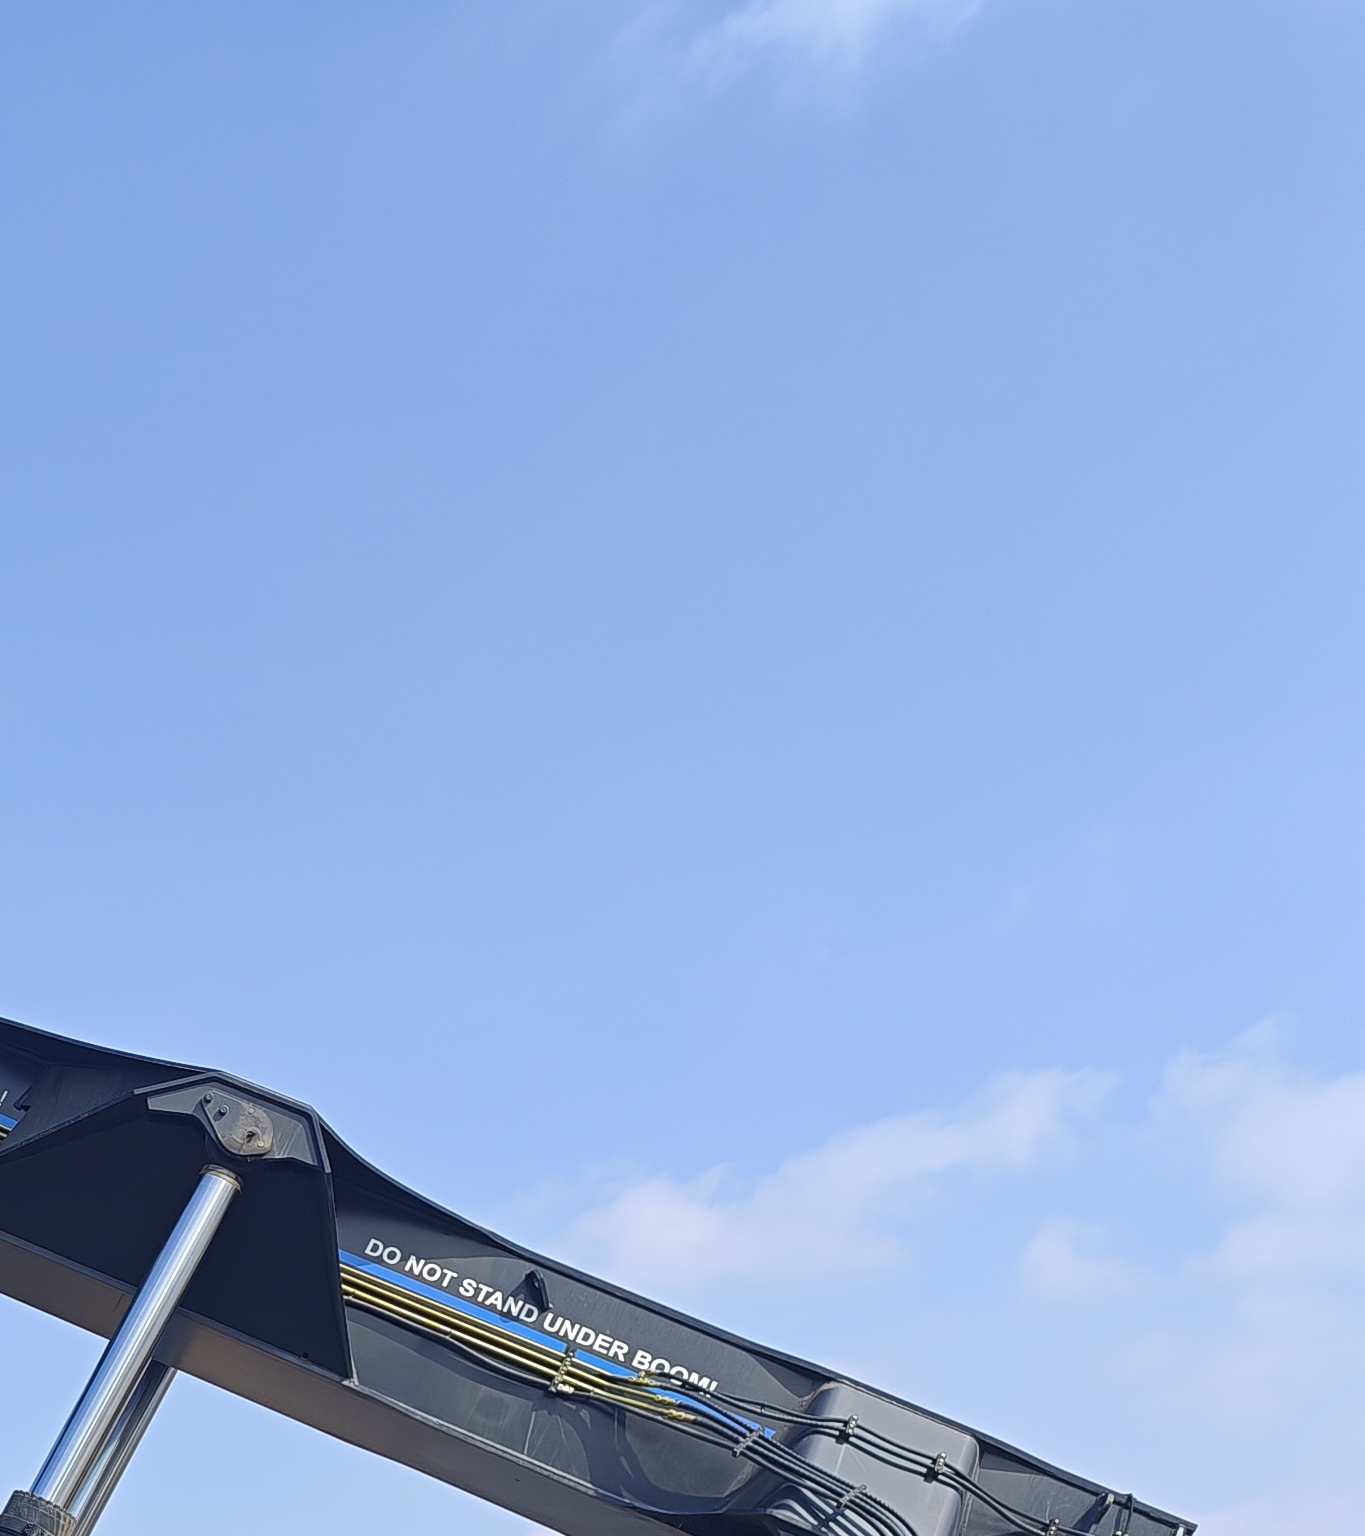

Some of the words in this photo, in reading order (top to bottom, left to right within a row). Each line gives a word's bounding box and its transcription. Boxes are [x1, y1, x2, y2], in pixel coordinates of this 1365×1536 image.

[364, 1237, 402, 1267] DO
[404, 1254, 458, 1290] NOT
[458, 1277, 540, 1325] STAND
[544, 1311, 629, 1364] UNDER
